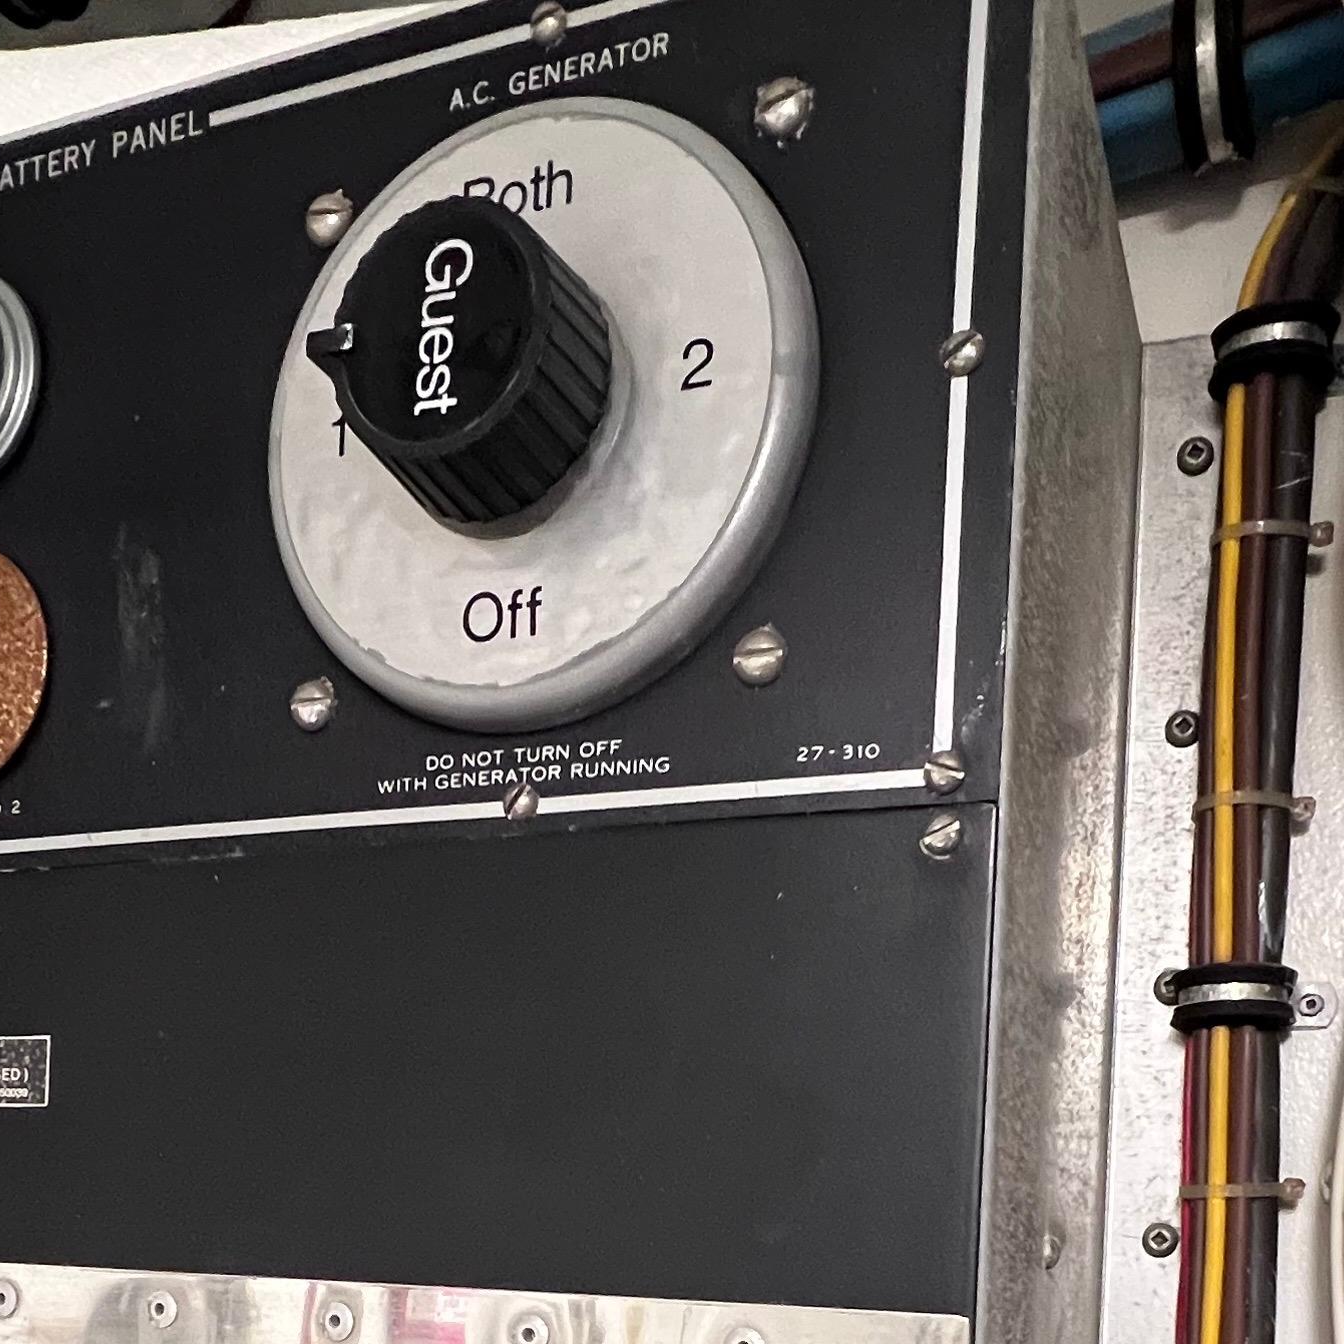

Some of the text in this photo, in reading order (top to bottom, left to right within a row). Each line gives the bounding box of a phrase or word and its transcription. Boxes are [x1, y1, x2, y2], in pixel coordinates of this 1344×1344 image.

[449, 32, 669, 111] A.C. GENERATOR
[112, 110, 203, 158] PANEL
[414, 238, 473, 416] Guest
[681, 338, 714, 391] 2
[332, 414, 346, 457] 1
[463, 585, 543, 643] Off
[377, 756, 671, 794] WITH GENERATOR RUNNING
[426, 739, 623, 771] DO NOT TURN OFF
[11, 800, 21, 814] 2
